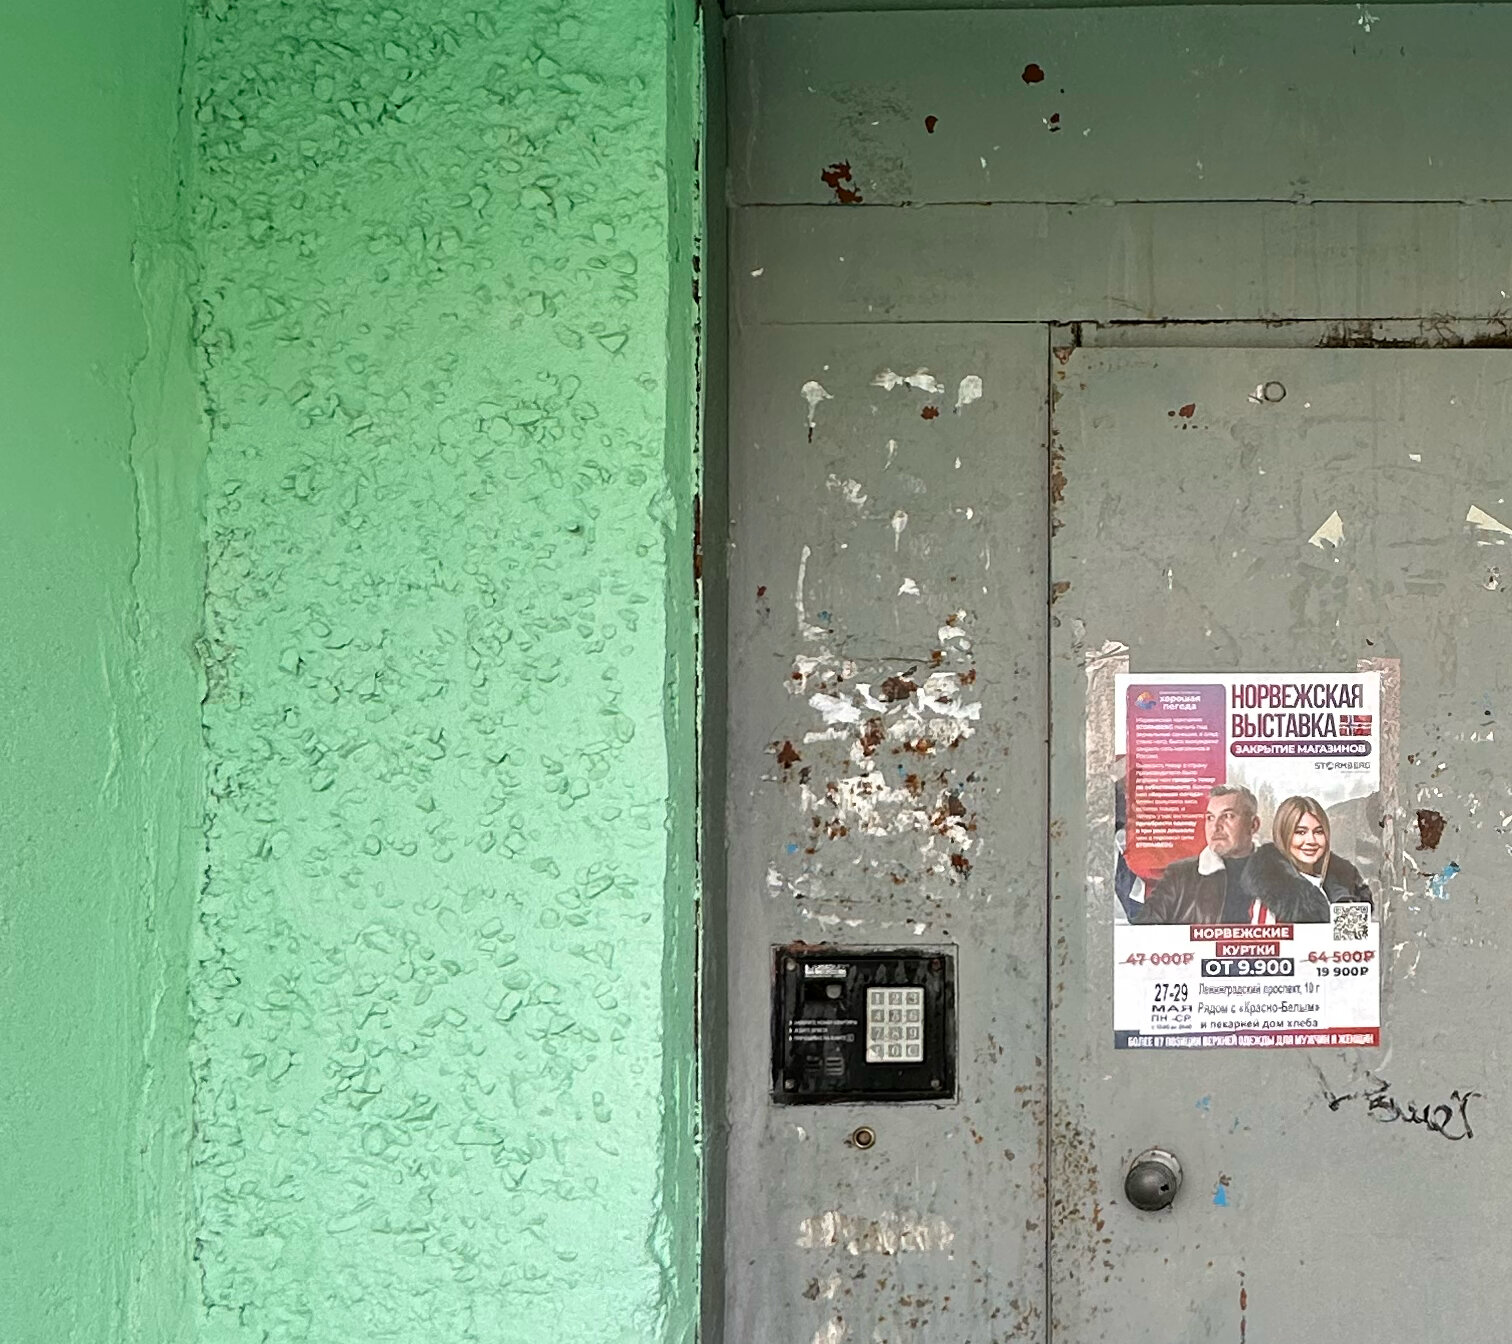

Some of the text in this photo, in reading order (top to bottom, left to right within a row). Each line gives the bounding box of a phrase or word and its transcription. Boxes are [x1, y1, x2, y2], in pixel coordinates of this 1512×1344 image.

[1232, 684, 1363, 709] НОРВЕЖСКАЯ
[1232, 713, 1337, 738] ВЫСТАВКА
[1235, 744, 1367, 754] ЗАКРЫТИЕ МАГАЗИНОВ
[1193, 928, 1290, 939] НОРВЕЖСКИЕ
[1222, 945, 1276, 956] КУРТКИ
[1205, 959, 1293, 975] ОТ 9.900
[1317, 967, 1331, 977] 19
[1154, 983, 1188, 1002] 27-29
[1199, 983, 1260, 996] Ленинградский
[1152, 1005, 1193, 1013] МАЯ
[1198, 1002, 1228, 1015] Рядом
[1230, 1005, 1236, 1013] с
[1151, 1014, 1168, 1022] ПН
[1200, 1018, 1319, 1030] и пекарней дом хлеба
[1127, 1036, 1153, 1047] БОЛЕЕ
[1203, 1034, 1237, 1046] ВЕРХНЕЙ
[1238, 1035, 1275, 1046] ОДЕЖДЫ
[1275, 1035, 1294, 1046] ДЛЯ
[1294, 1034, 1330, 1045] МУЖЧИН
